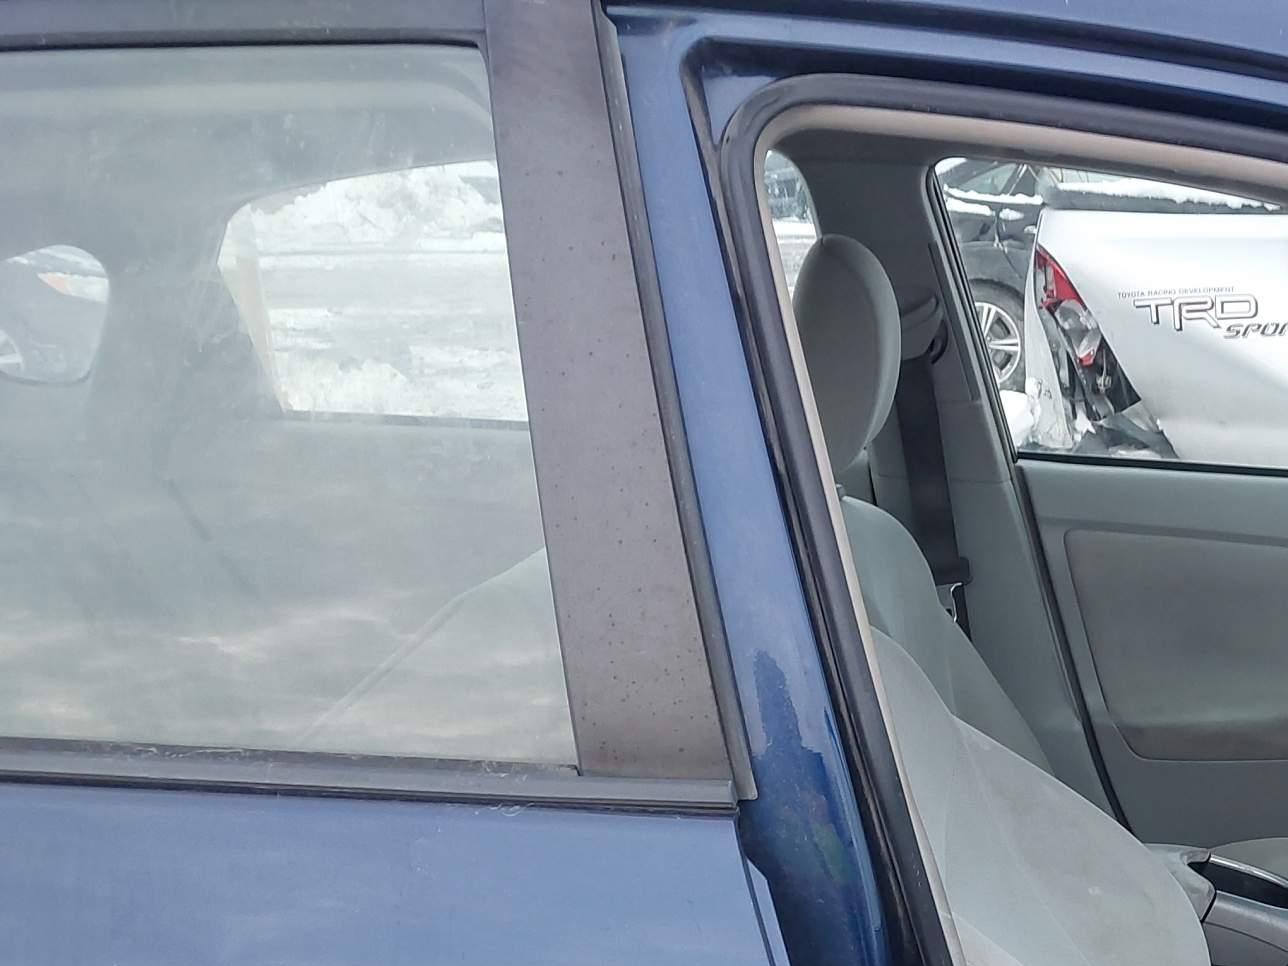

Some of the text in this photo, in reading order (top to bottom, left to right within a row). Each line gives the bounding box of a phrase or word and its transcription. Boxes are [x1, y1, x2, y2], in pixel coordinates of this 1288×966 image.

[1118, 286, 1235, 299] TOYOTA RACING DEVELOPMENT
[1133, 294, 1258, 331] TRD
